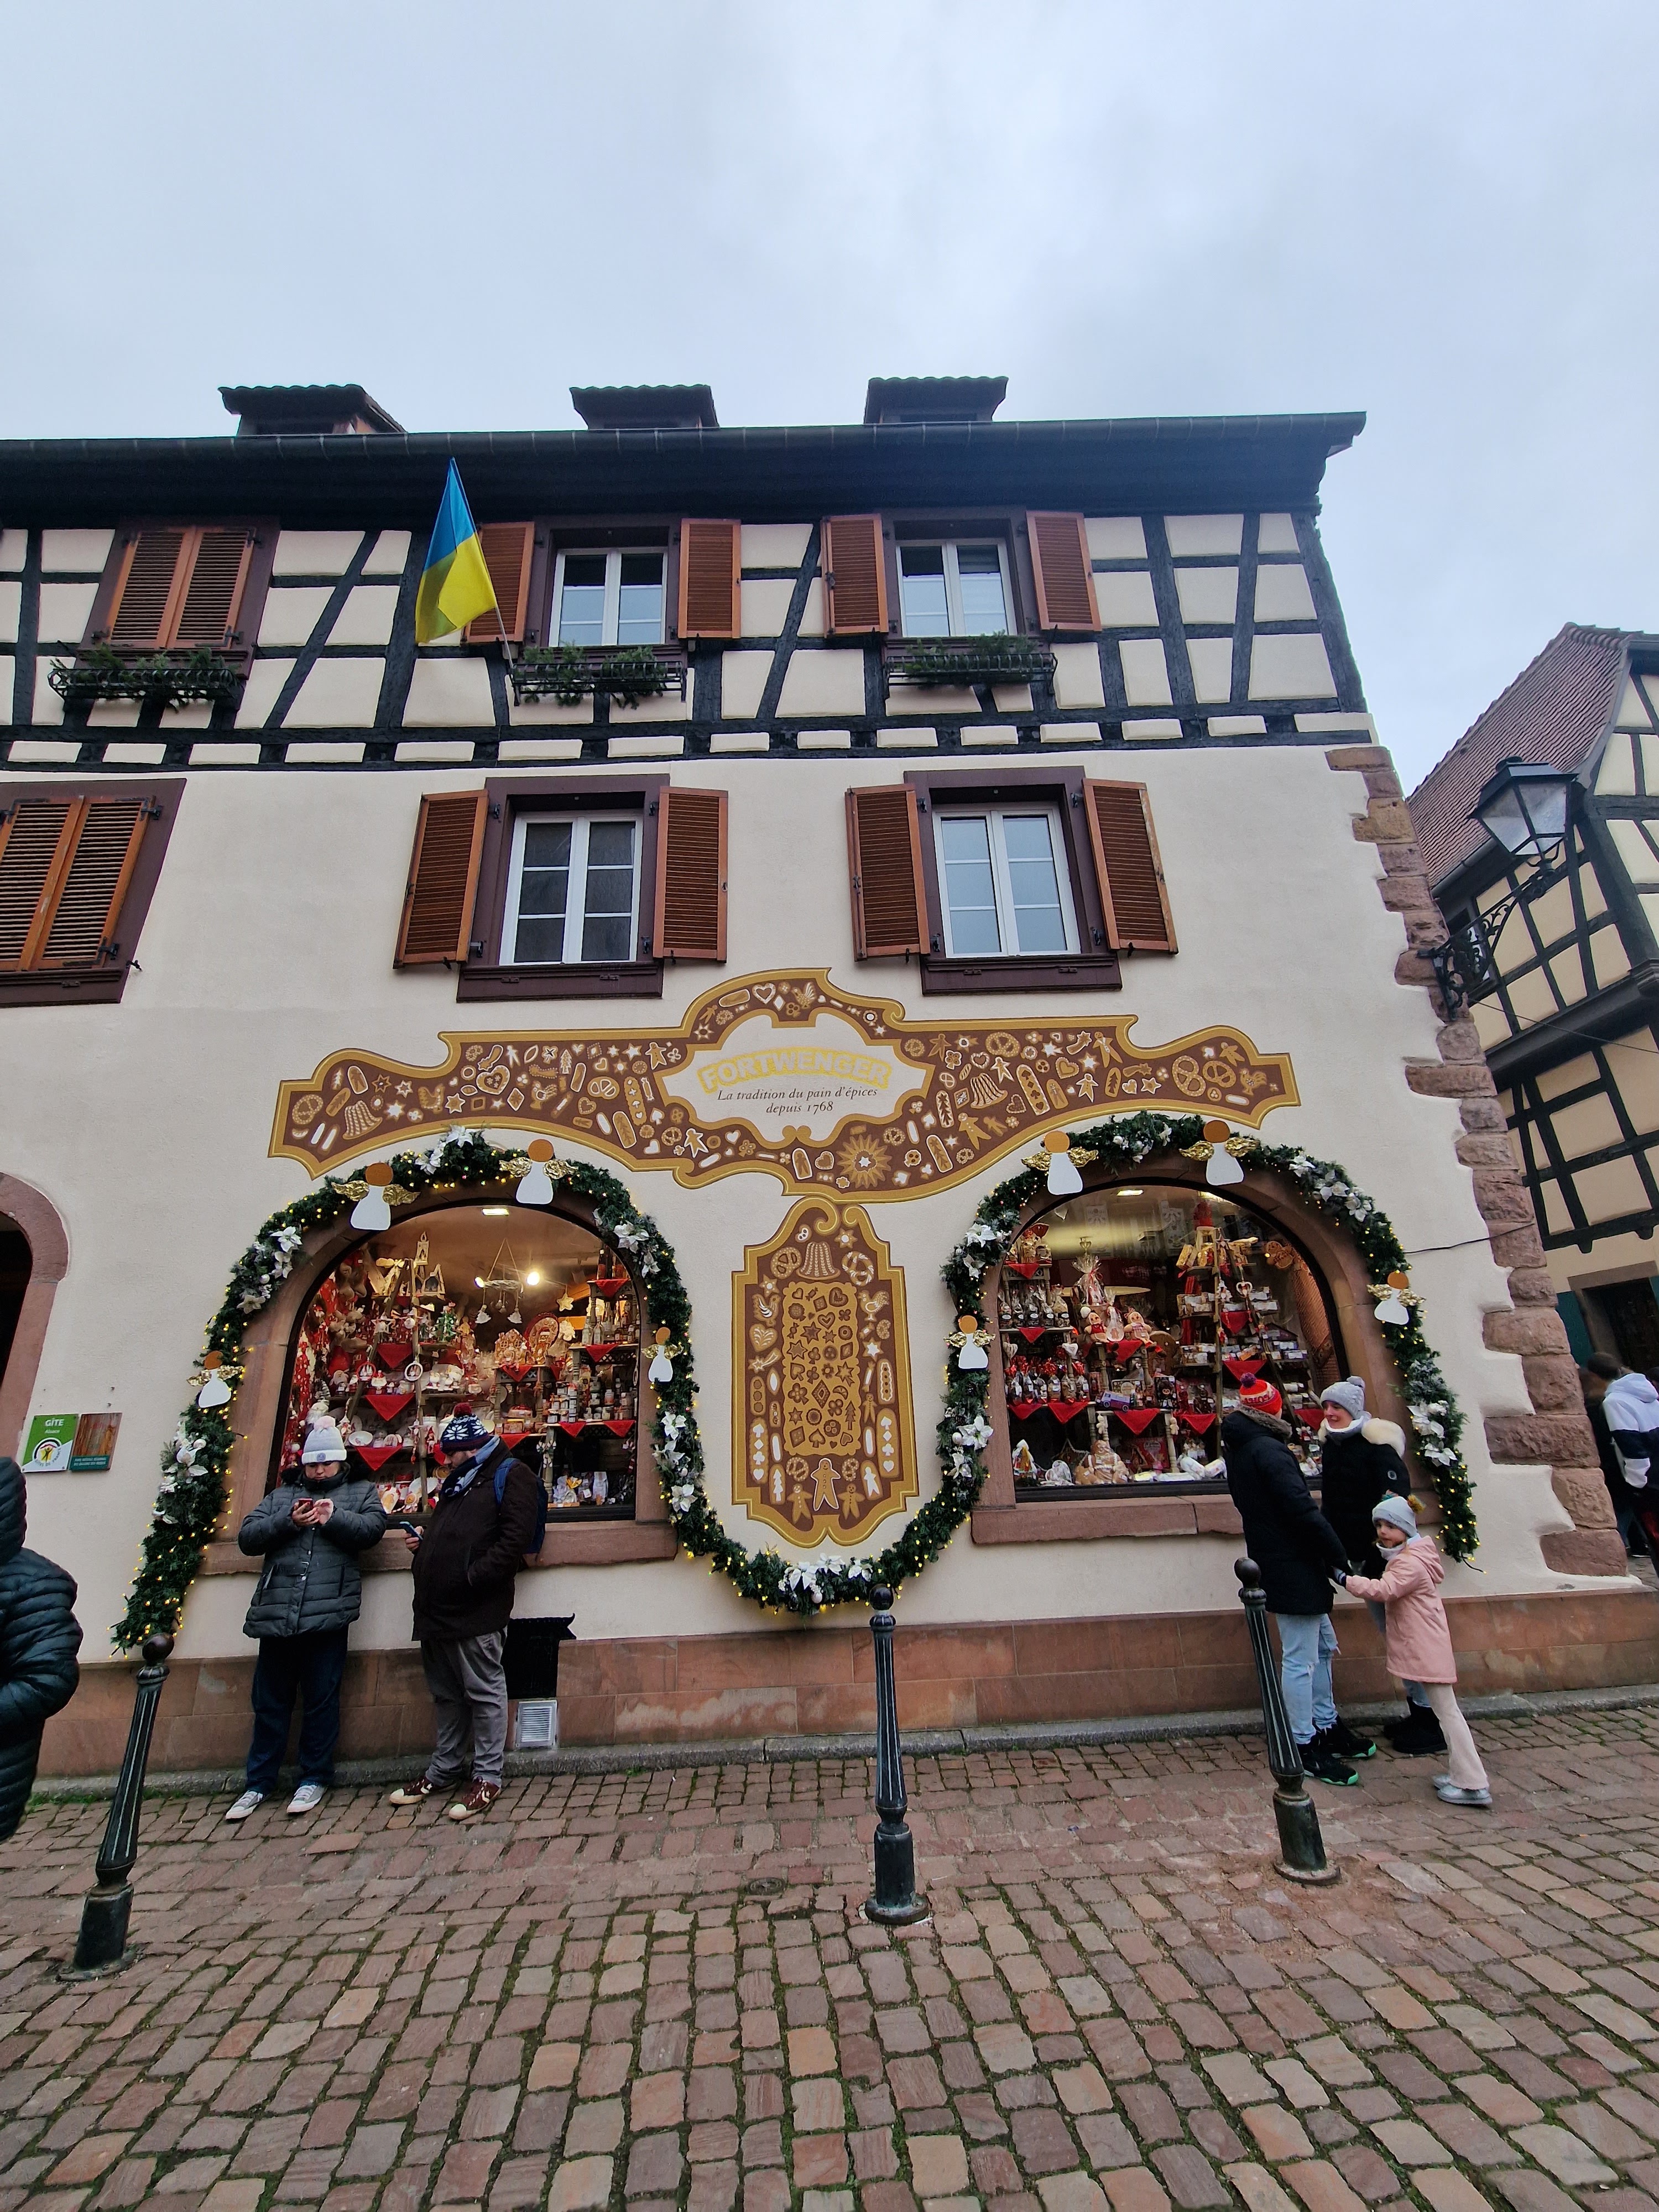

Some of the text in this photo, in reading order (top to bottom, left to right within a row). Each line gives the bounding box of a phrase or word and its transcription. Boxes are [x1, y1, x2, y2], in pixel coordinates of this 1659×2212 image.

[701, 1050, 887, 1091] FORTWENGER
[718, 1086, 878, 1103] La tradition du pain d'épices
[766, 1101, 833, 1116] depuis 1768
